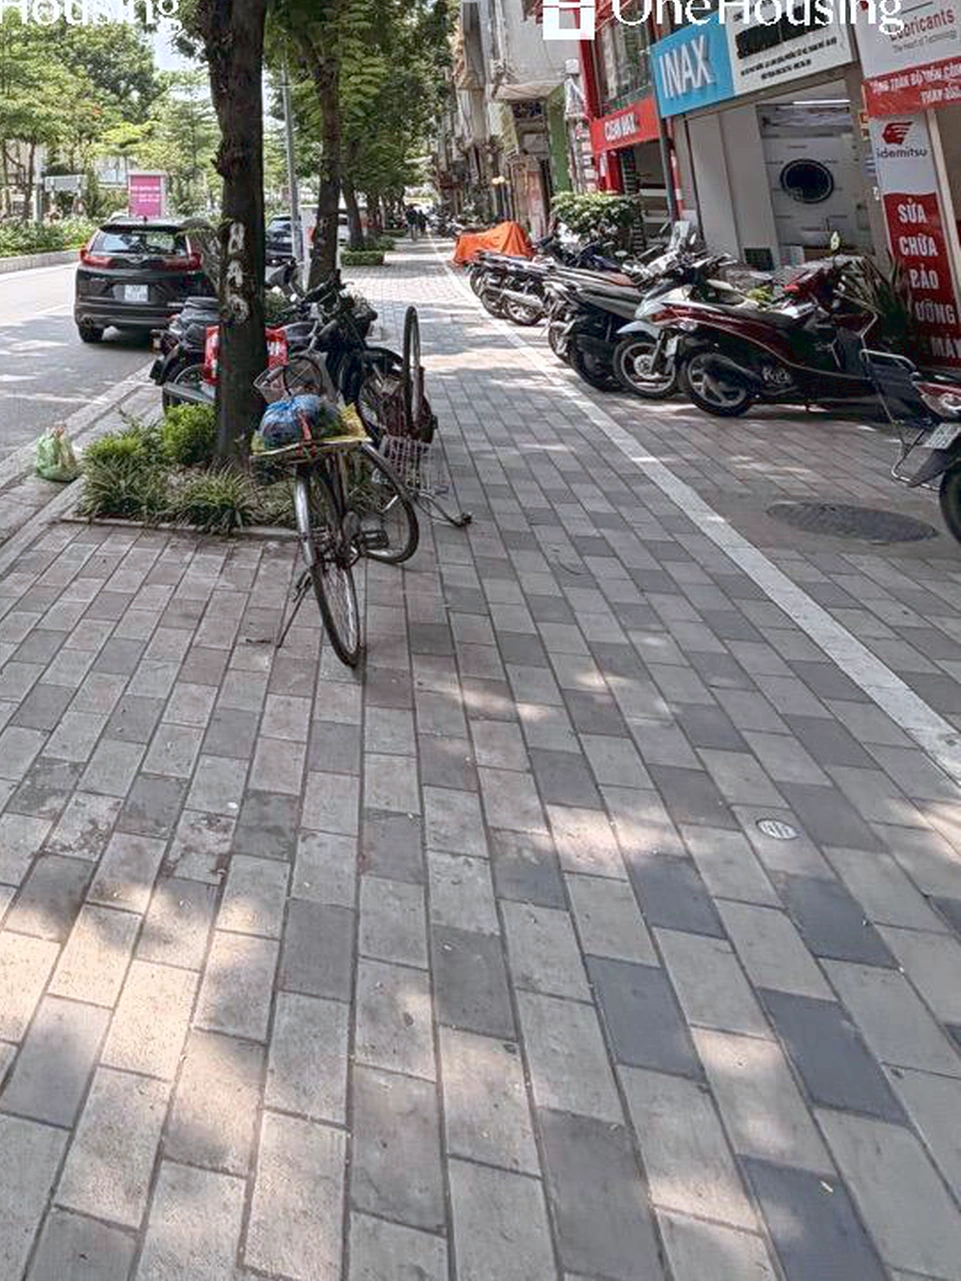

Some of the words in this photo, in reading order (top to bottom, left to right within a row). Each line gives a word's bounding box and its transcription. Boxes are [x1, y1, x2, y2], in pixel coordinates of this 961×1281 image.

[659, 34, 712, 99] INAX
[877, 147, 928, 159] idemitsu
[897, 197, 927, 224] SỬA
[899, 234, 938, 257] CHỮA
[915, 299, 957, 325] ƯỠNG
